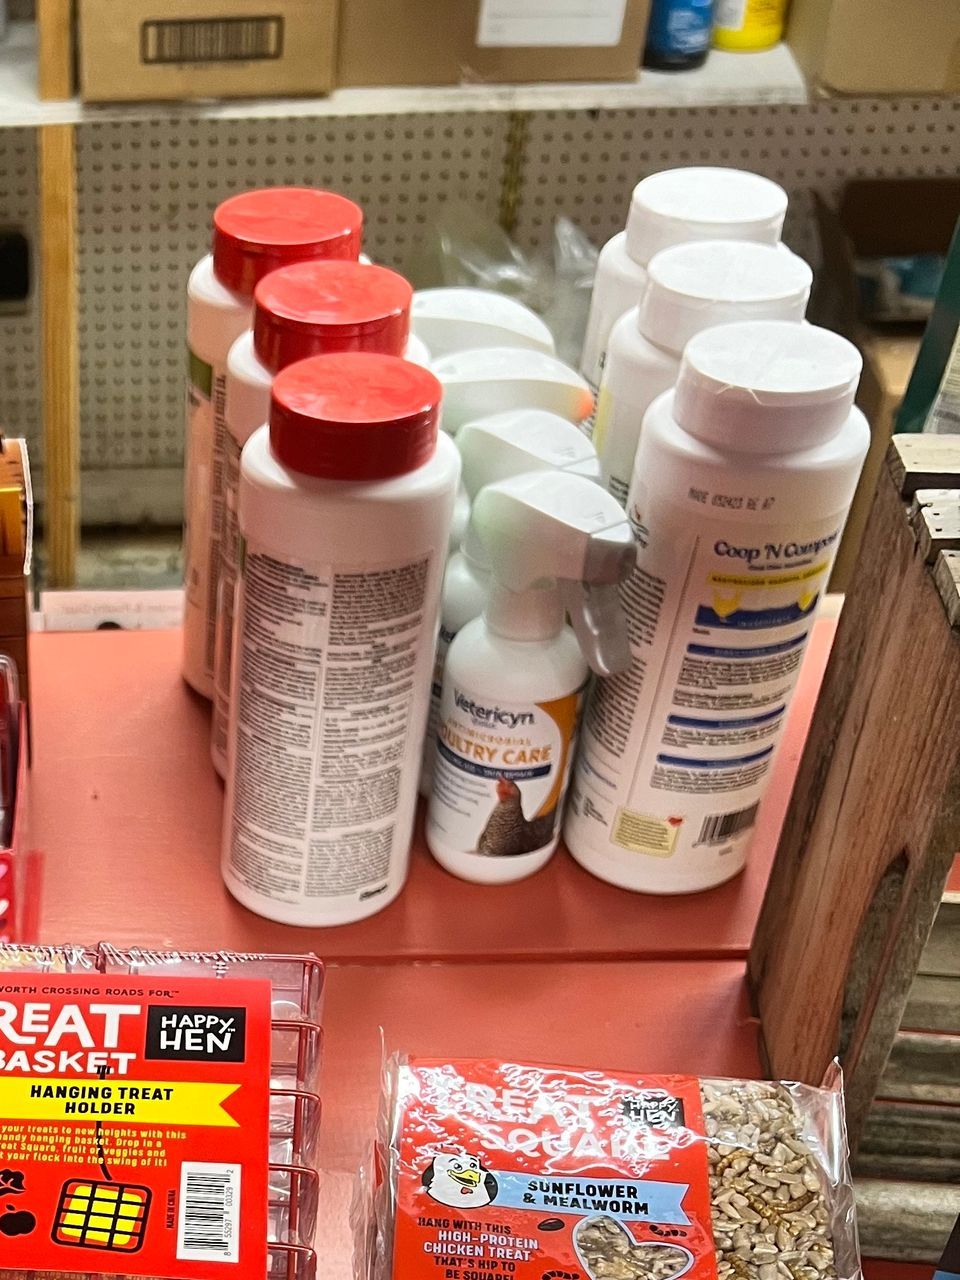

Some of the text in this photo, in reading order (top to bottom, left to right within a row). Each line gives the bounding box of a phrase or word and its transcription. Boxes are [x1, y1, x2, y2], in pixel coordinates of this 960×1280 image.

[714, 538, 761, 563] Coop
[454, 688, 535, 729] Vetericyn
[502, 744, 552, 766] CARE
[42, 986, 100, 997] CROSSING
[105, 987, 145, 997] ROADS
[30, 1085, 174, 1101] HANGING TREAT
[65, 1101, 136, 1115] HOLDER
[527, 1180, 638, 1199] SUNFLOWER
[523, 1192, 649, 1215] & MEALWORM
[438, 1230, 538, 1250] HIGH-PROTEIN
[423, 1241, 531, 1261] CHICKEN TREAT
[434, 1255, 516, 1272] THAT'S HIP TO
[445, 1269, 461, 1280] BE
